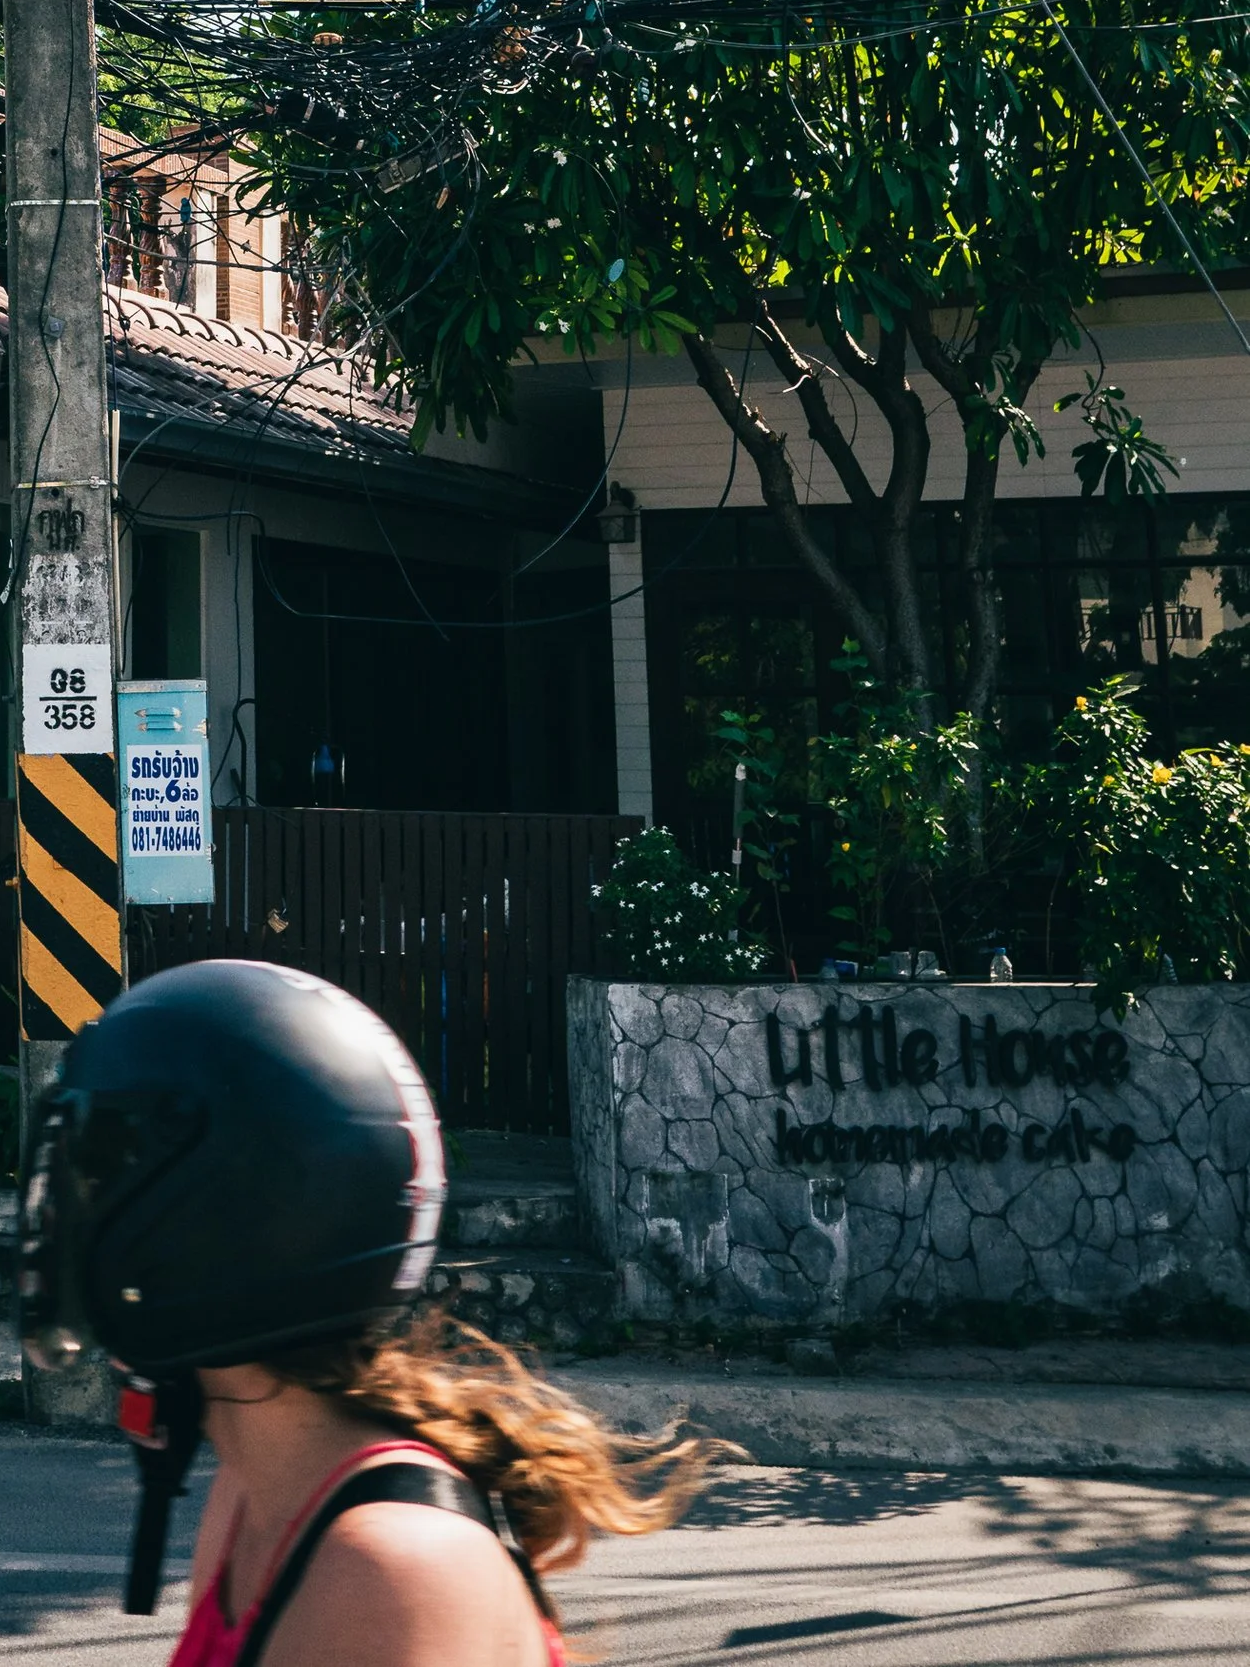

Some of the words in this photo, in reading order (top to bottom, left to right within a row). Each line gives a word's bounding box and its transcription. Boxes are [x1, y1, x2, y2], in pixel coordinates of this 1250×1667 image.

[43, 704, 96, 730] 358
[131, 750, 199, 778] รถรับจ้าง
[132, 826, 201, 851] 081-7486446
[765, 1005, 940, 1092] Little
[959, 1013, 1132, 1089] House
[775, 1108, 1010, 1165] homemade
[1021, 1107, 1137, 1164] cake
